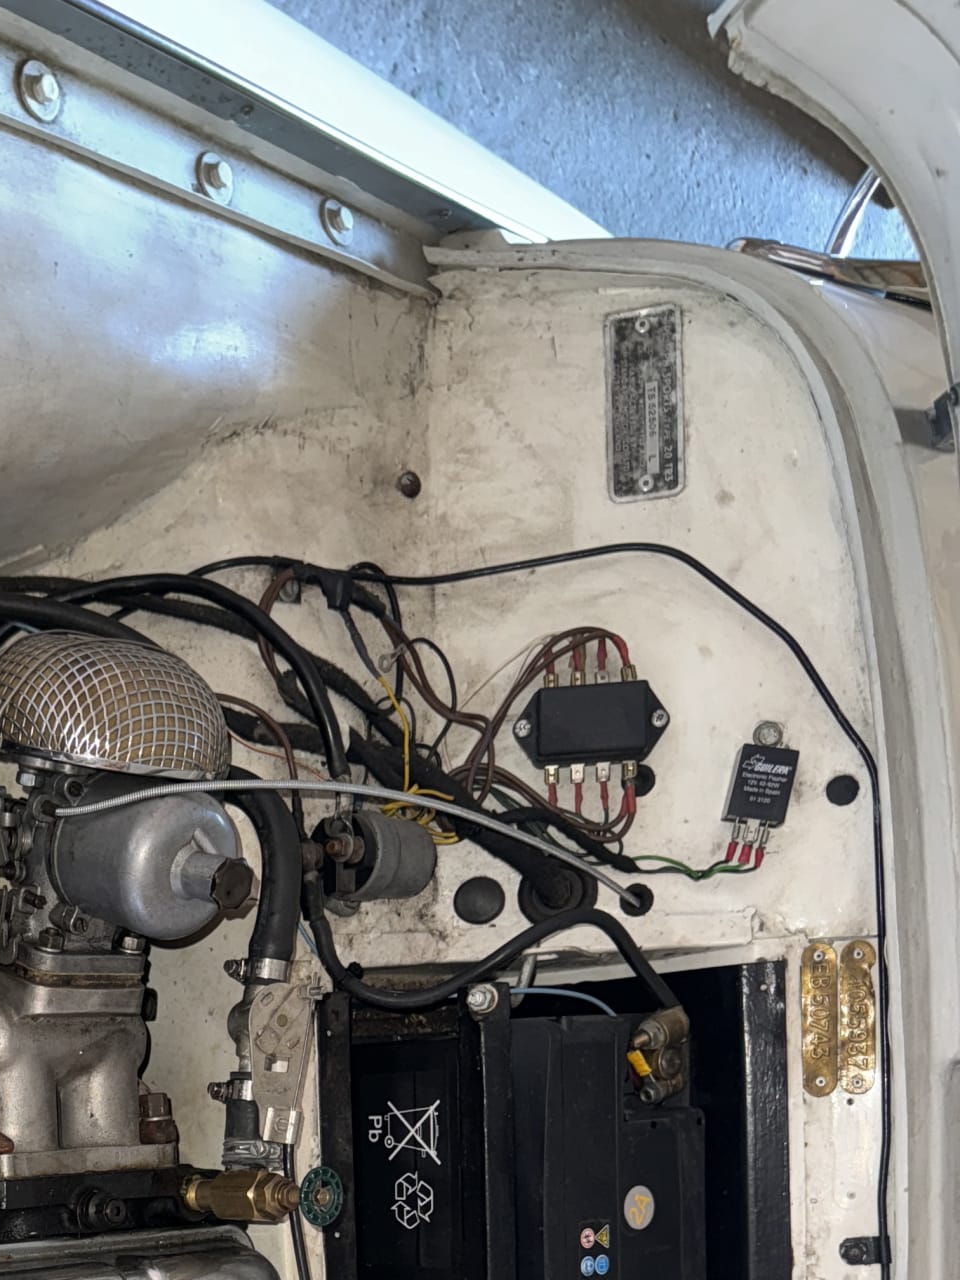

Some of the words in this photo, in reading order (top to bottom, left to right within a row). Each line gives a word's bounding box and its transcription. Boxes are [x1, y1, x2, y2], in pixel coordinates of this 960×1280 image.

[648, 454, 656, 463] L
[663, 446, 673, 459] 20
[664, 462, 674, 482] TR3
[765, 788, 781, 796] Spain
[809, 962, 832, 990] EB
[809, 994, 832, 1060] 50743
[368, 1115, 382, 1143] Pb
